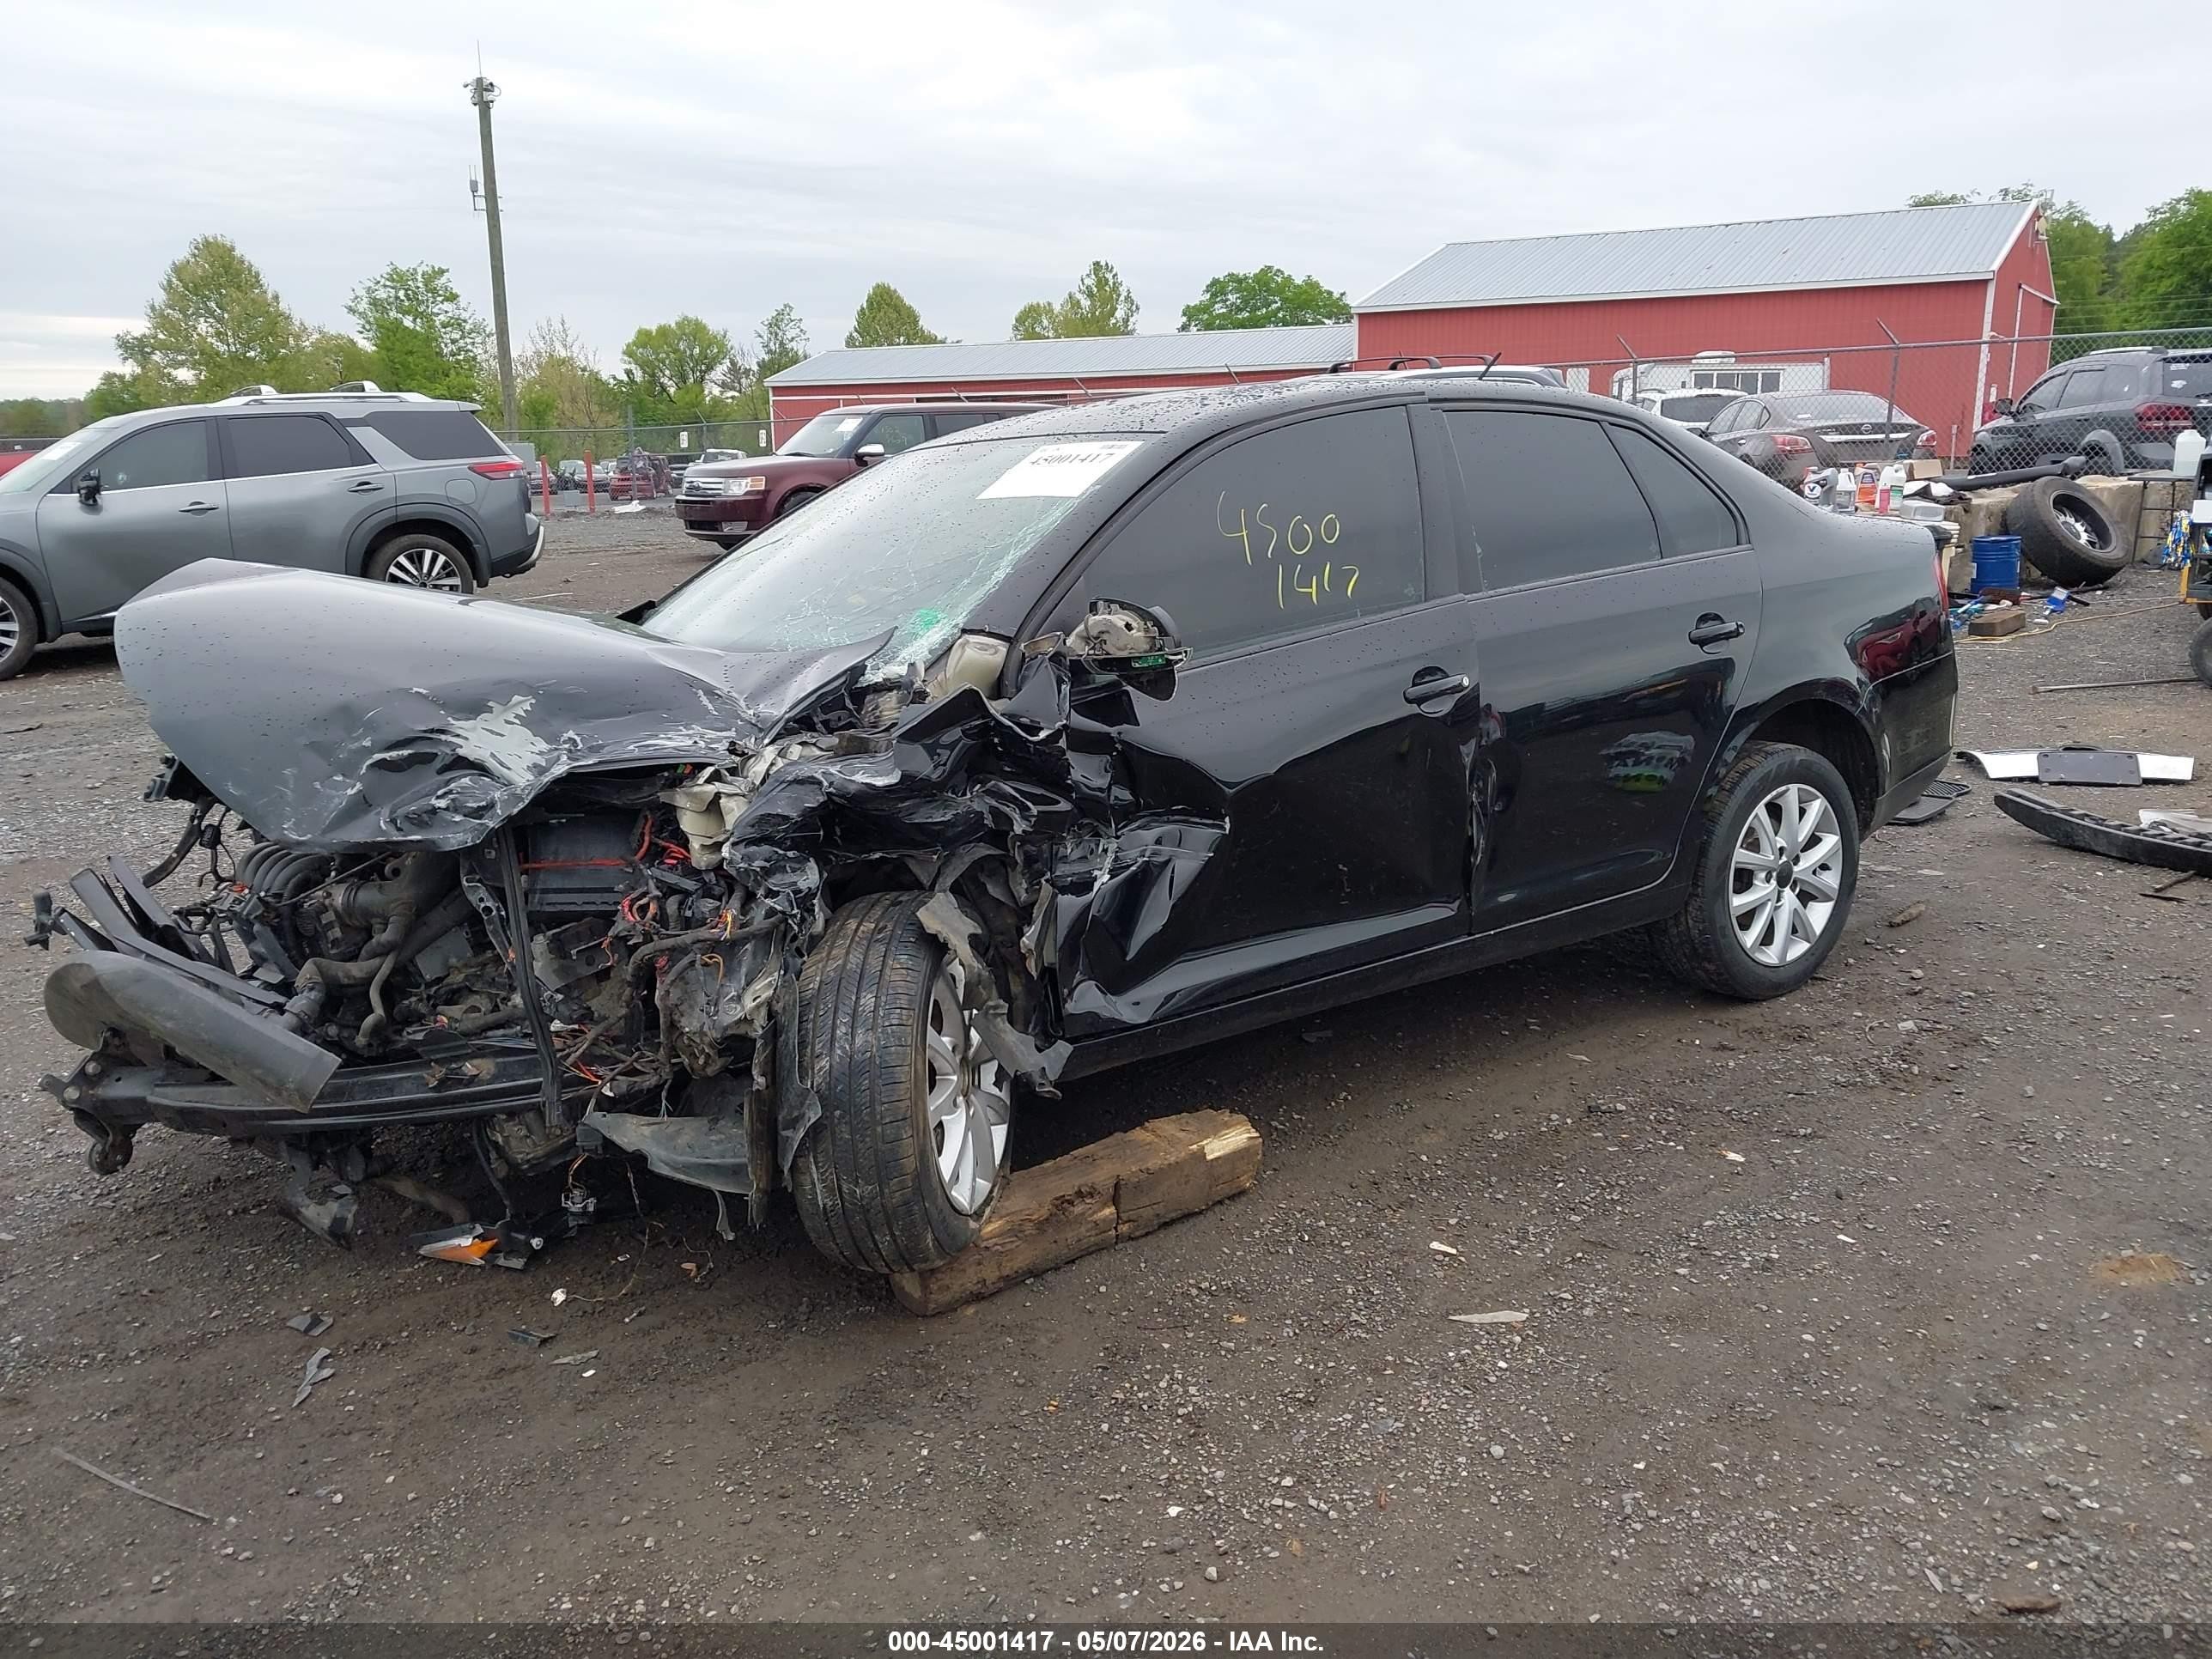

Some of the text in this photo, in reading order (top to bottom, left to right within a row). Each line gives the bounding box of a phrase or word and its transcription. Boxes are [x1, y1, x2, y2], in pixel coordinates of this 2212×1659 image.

[1030, 453, 1116, 465] 45001417
[1217, 490, 1340, 566] 4500
[1278, 561, 1360, 610] 1417
